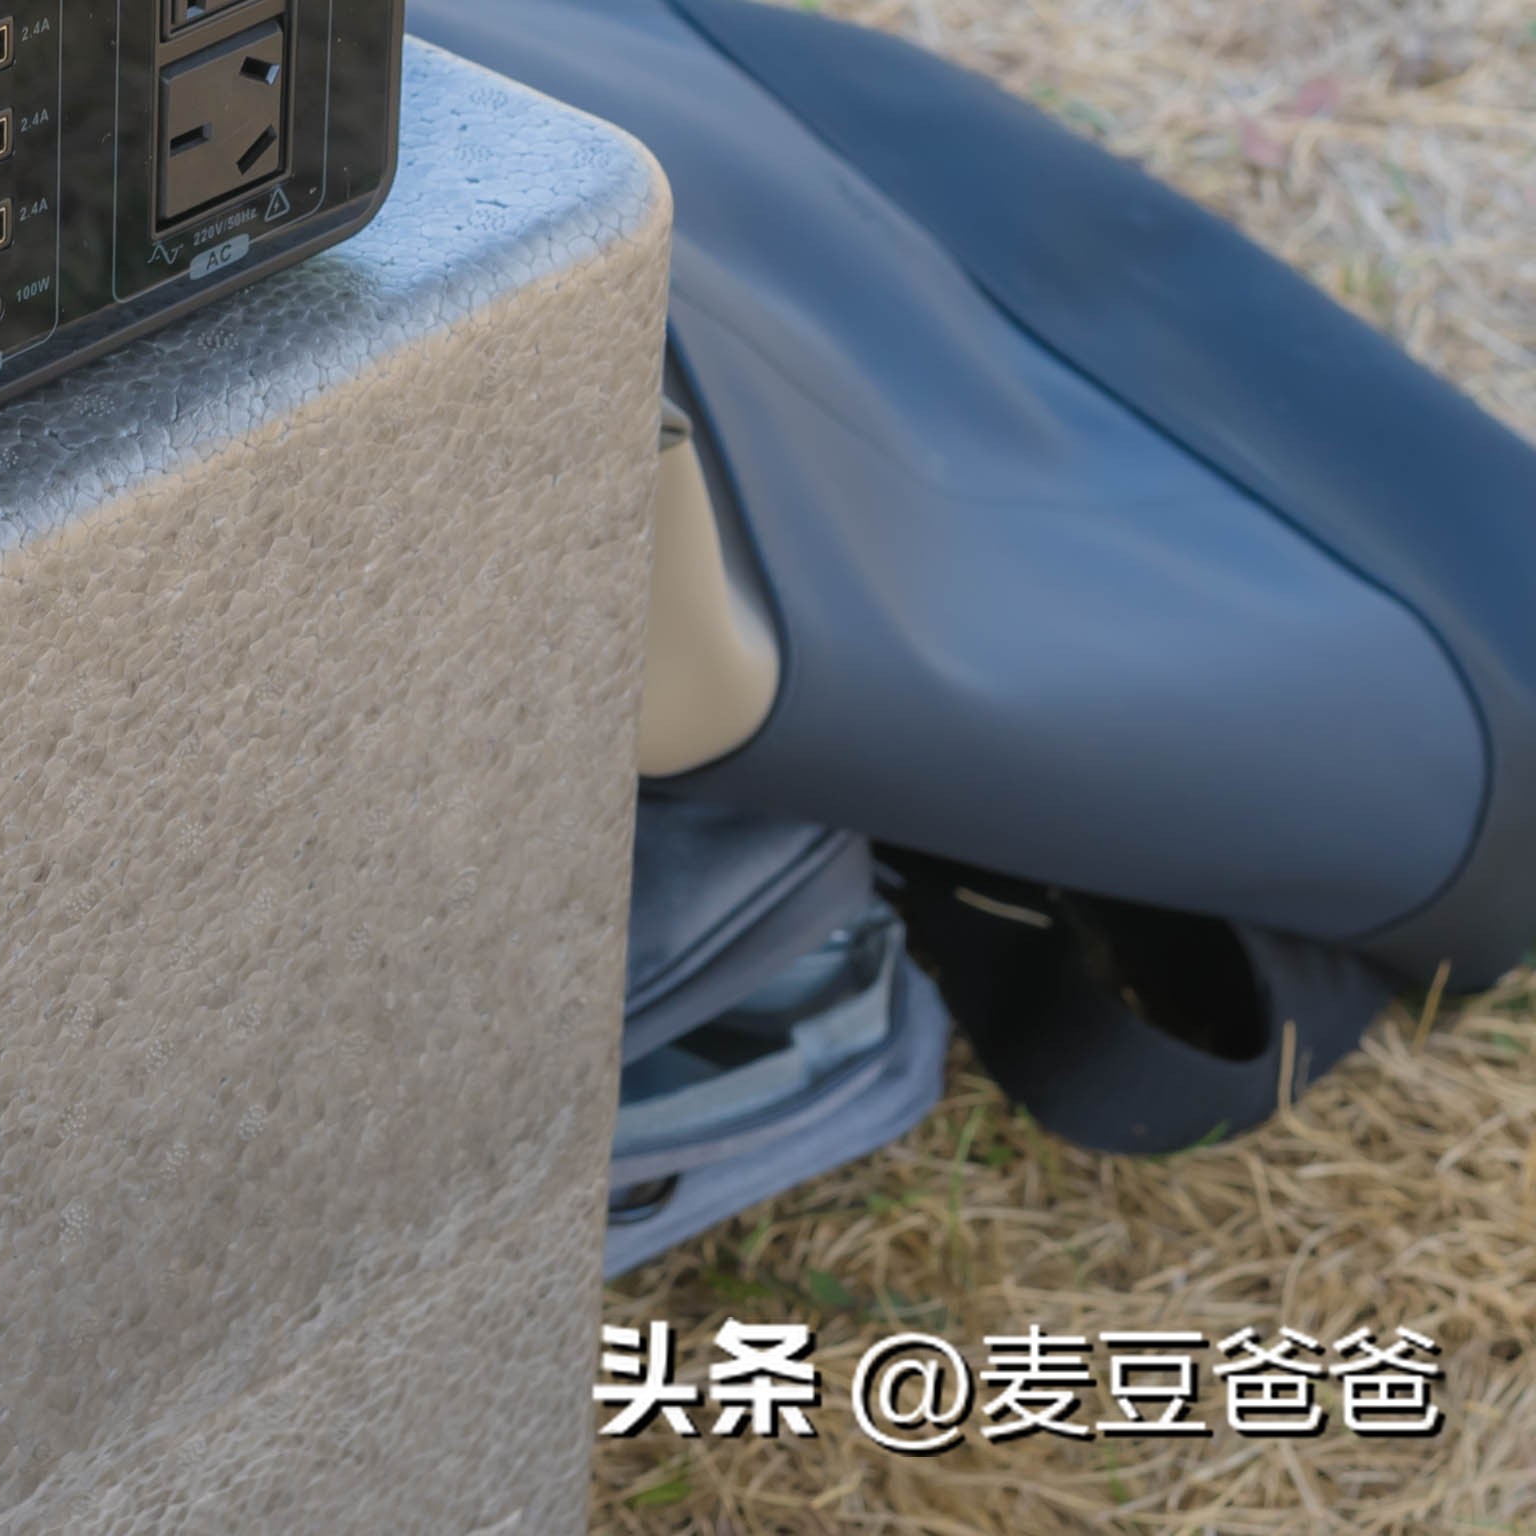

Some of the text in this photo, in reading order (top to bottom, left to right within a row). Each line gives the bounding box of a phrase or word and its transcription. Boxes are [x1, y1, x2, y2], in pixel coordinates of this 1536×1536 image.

[21, 17, 51, 42] 2.4A
[20, 108, 49, 133] 2.4A
[19, 197, 49, 222] 2.4A
[206, 244, 232, 270] AC
[16, 275, 50, 302] 100W
